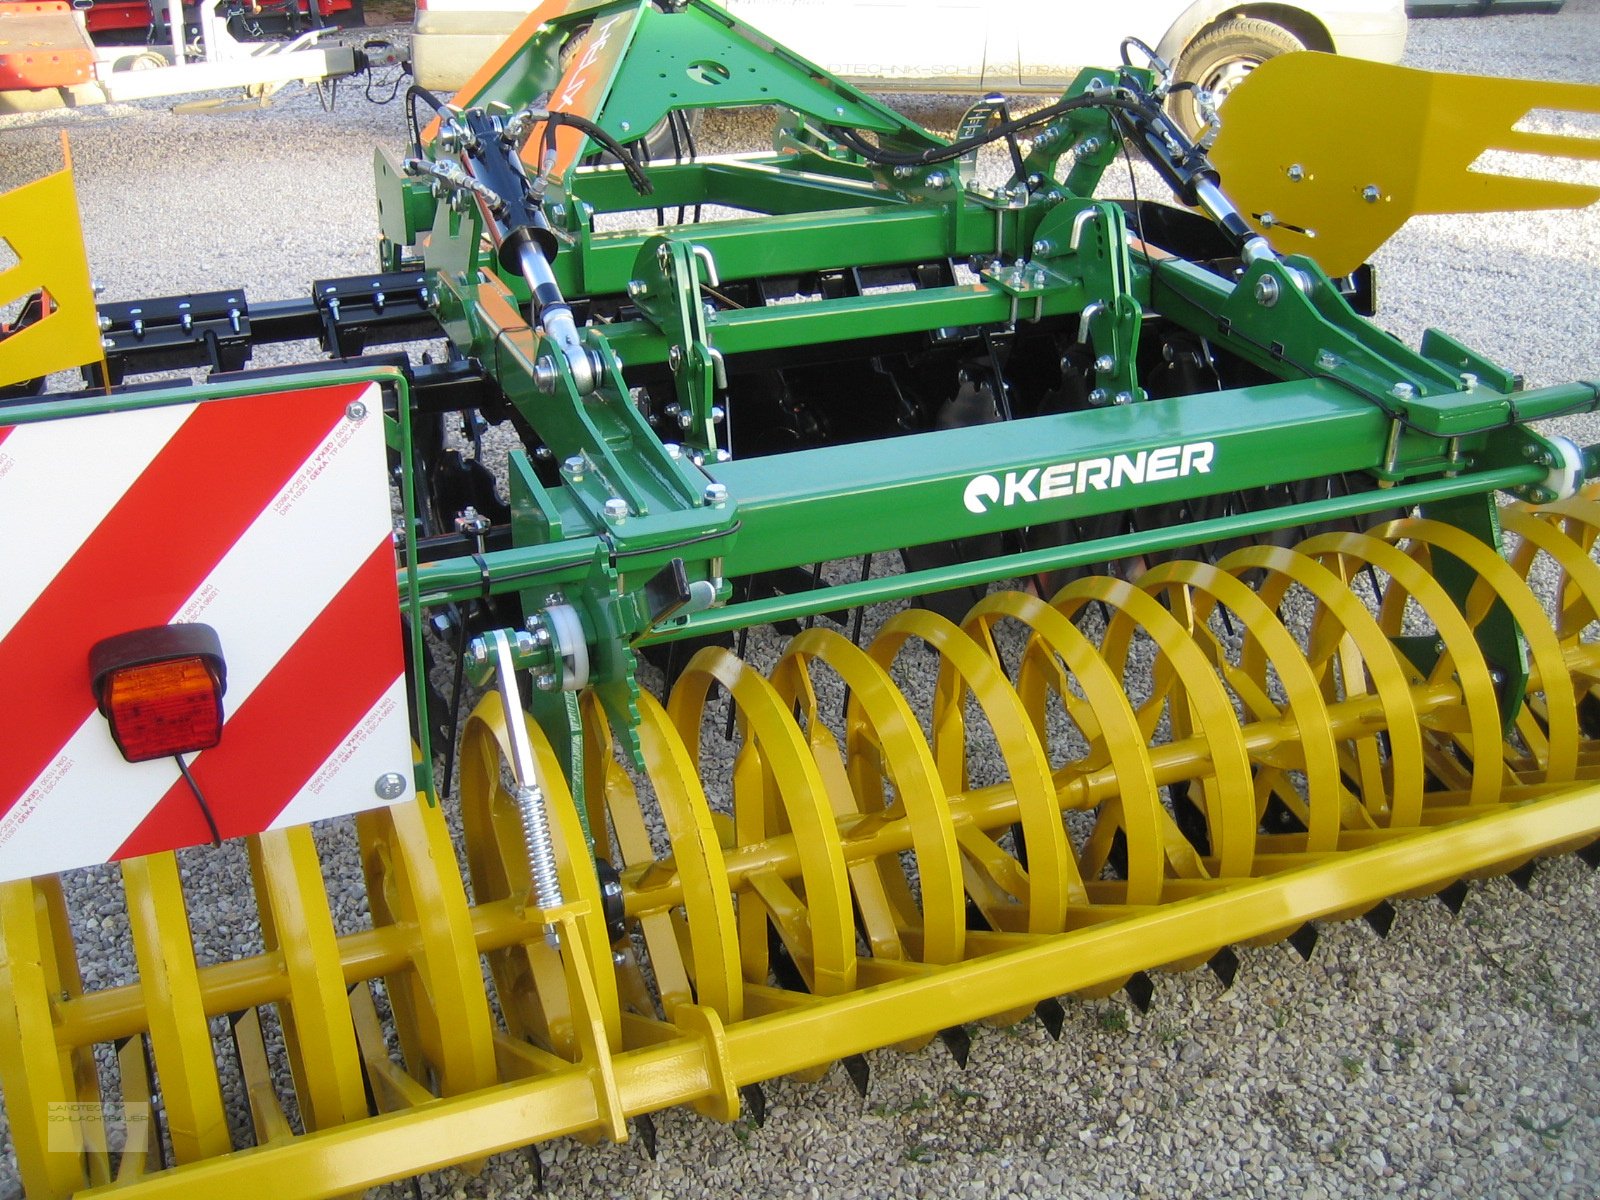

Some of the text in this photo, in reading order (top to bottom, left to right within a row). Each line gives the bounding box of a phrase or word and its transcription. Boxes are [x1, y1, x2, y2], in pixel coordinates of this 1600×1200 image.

[827, 63, 1090, 76] DTECHNIK-SCHLACHTBAU
[315, 441, 334, 463] GEKA
[1003, 441, 1214, 507] KERNER
[279, 502, 292, 516] DIN
[309, 459, 329, 481] GEKA
[346, 729, 364, 748] GEKA
[341, 745, 358, 764] GEKA
[22, 788, 40, 809] GEKA
[17, 804, 36, 825] GEKA
